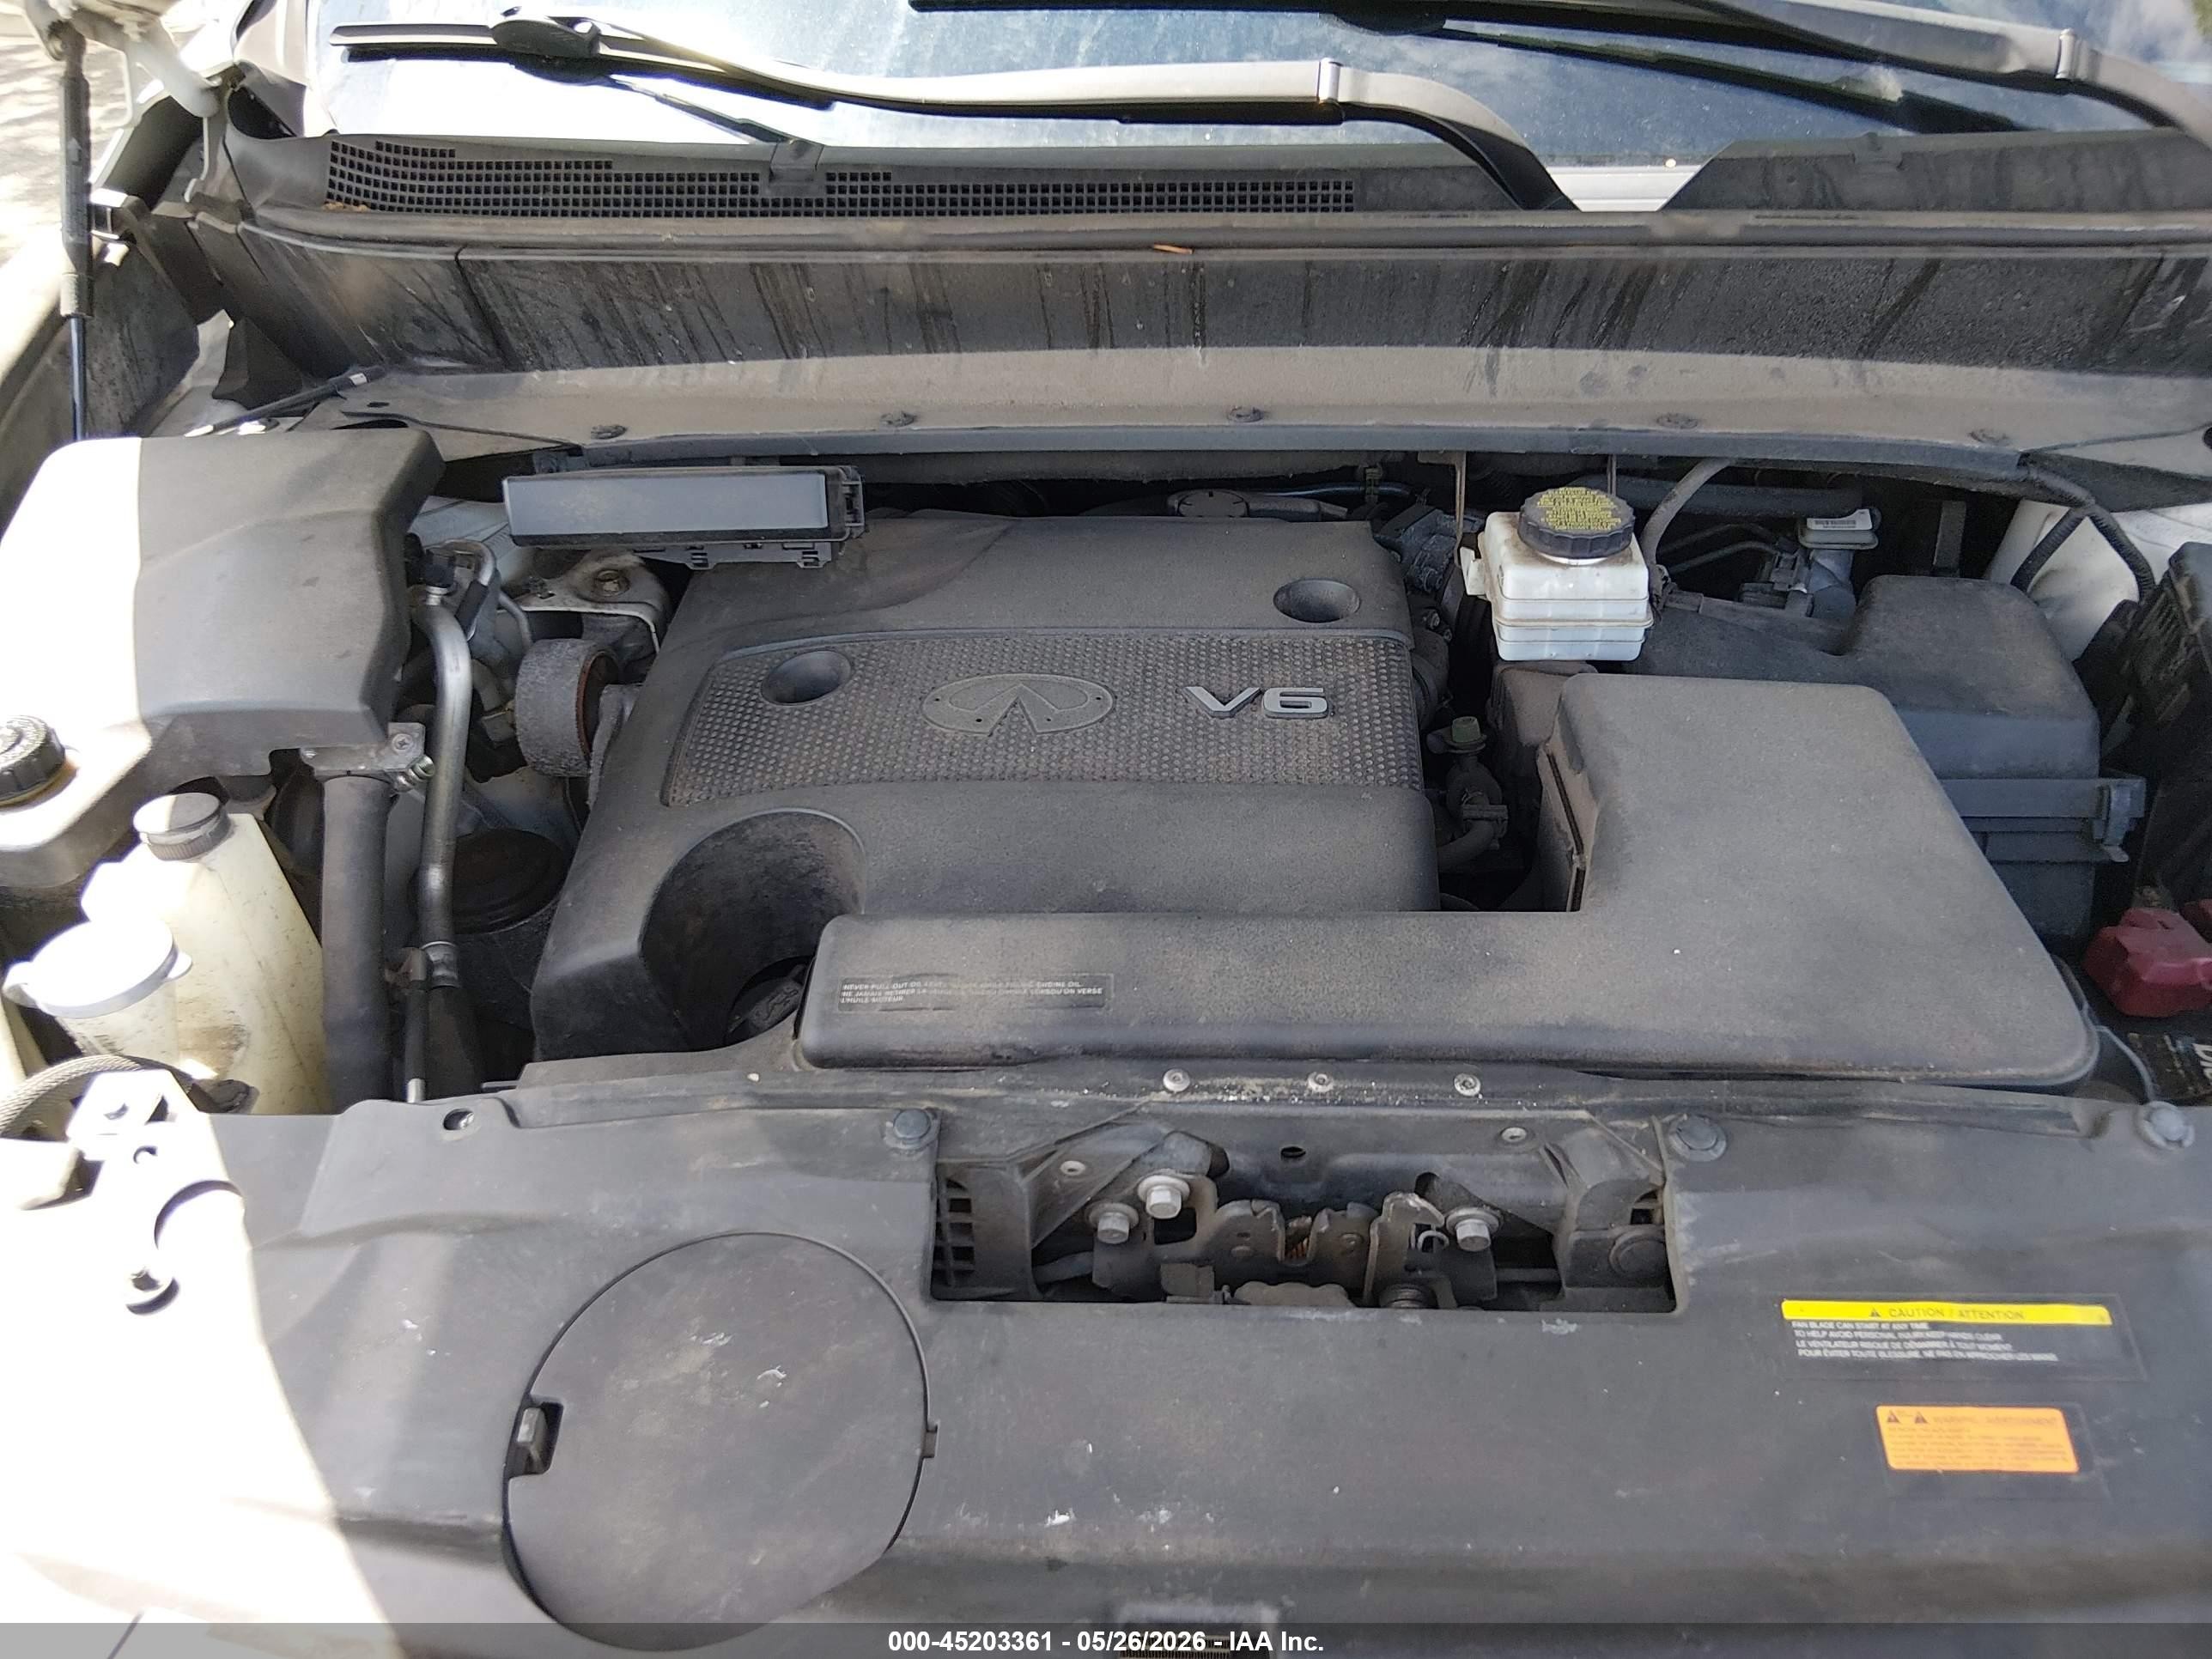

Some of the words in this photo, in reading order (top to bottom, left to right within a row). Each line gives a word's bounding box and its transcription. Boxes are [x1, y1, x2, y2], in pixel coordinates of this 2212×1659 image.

[1182, 686, 1329, 719] V6
[1888, 1308, 1945, 1318] CAUTION
[1958, 1310, 2026, 1320] ATTENTION
